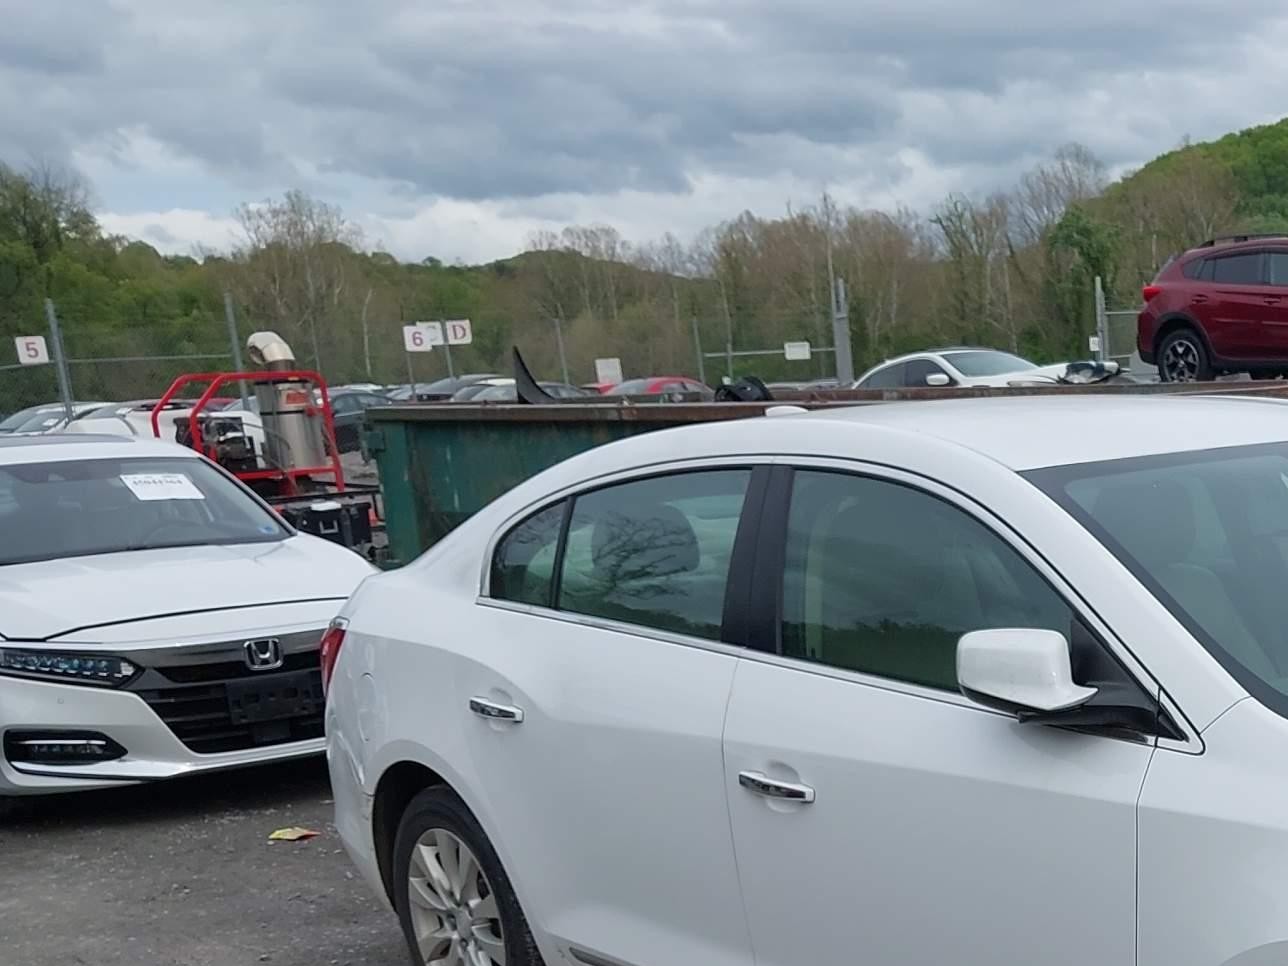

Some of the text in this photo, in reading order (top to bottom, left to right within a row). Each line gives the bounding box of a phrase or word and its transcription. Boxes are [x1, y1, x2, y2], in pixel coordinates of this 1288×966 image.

[411, 331, 424, 347] 6
[452, 325, 467, 340] D
[25, 342, 40, 359] 5
